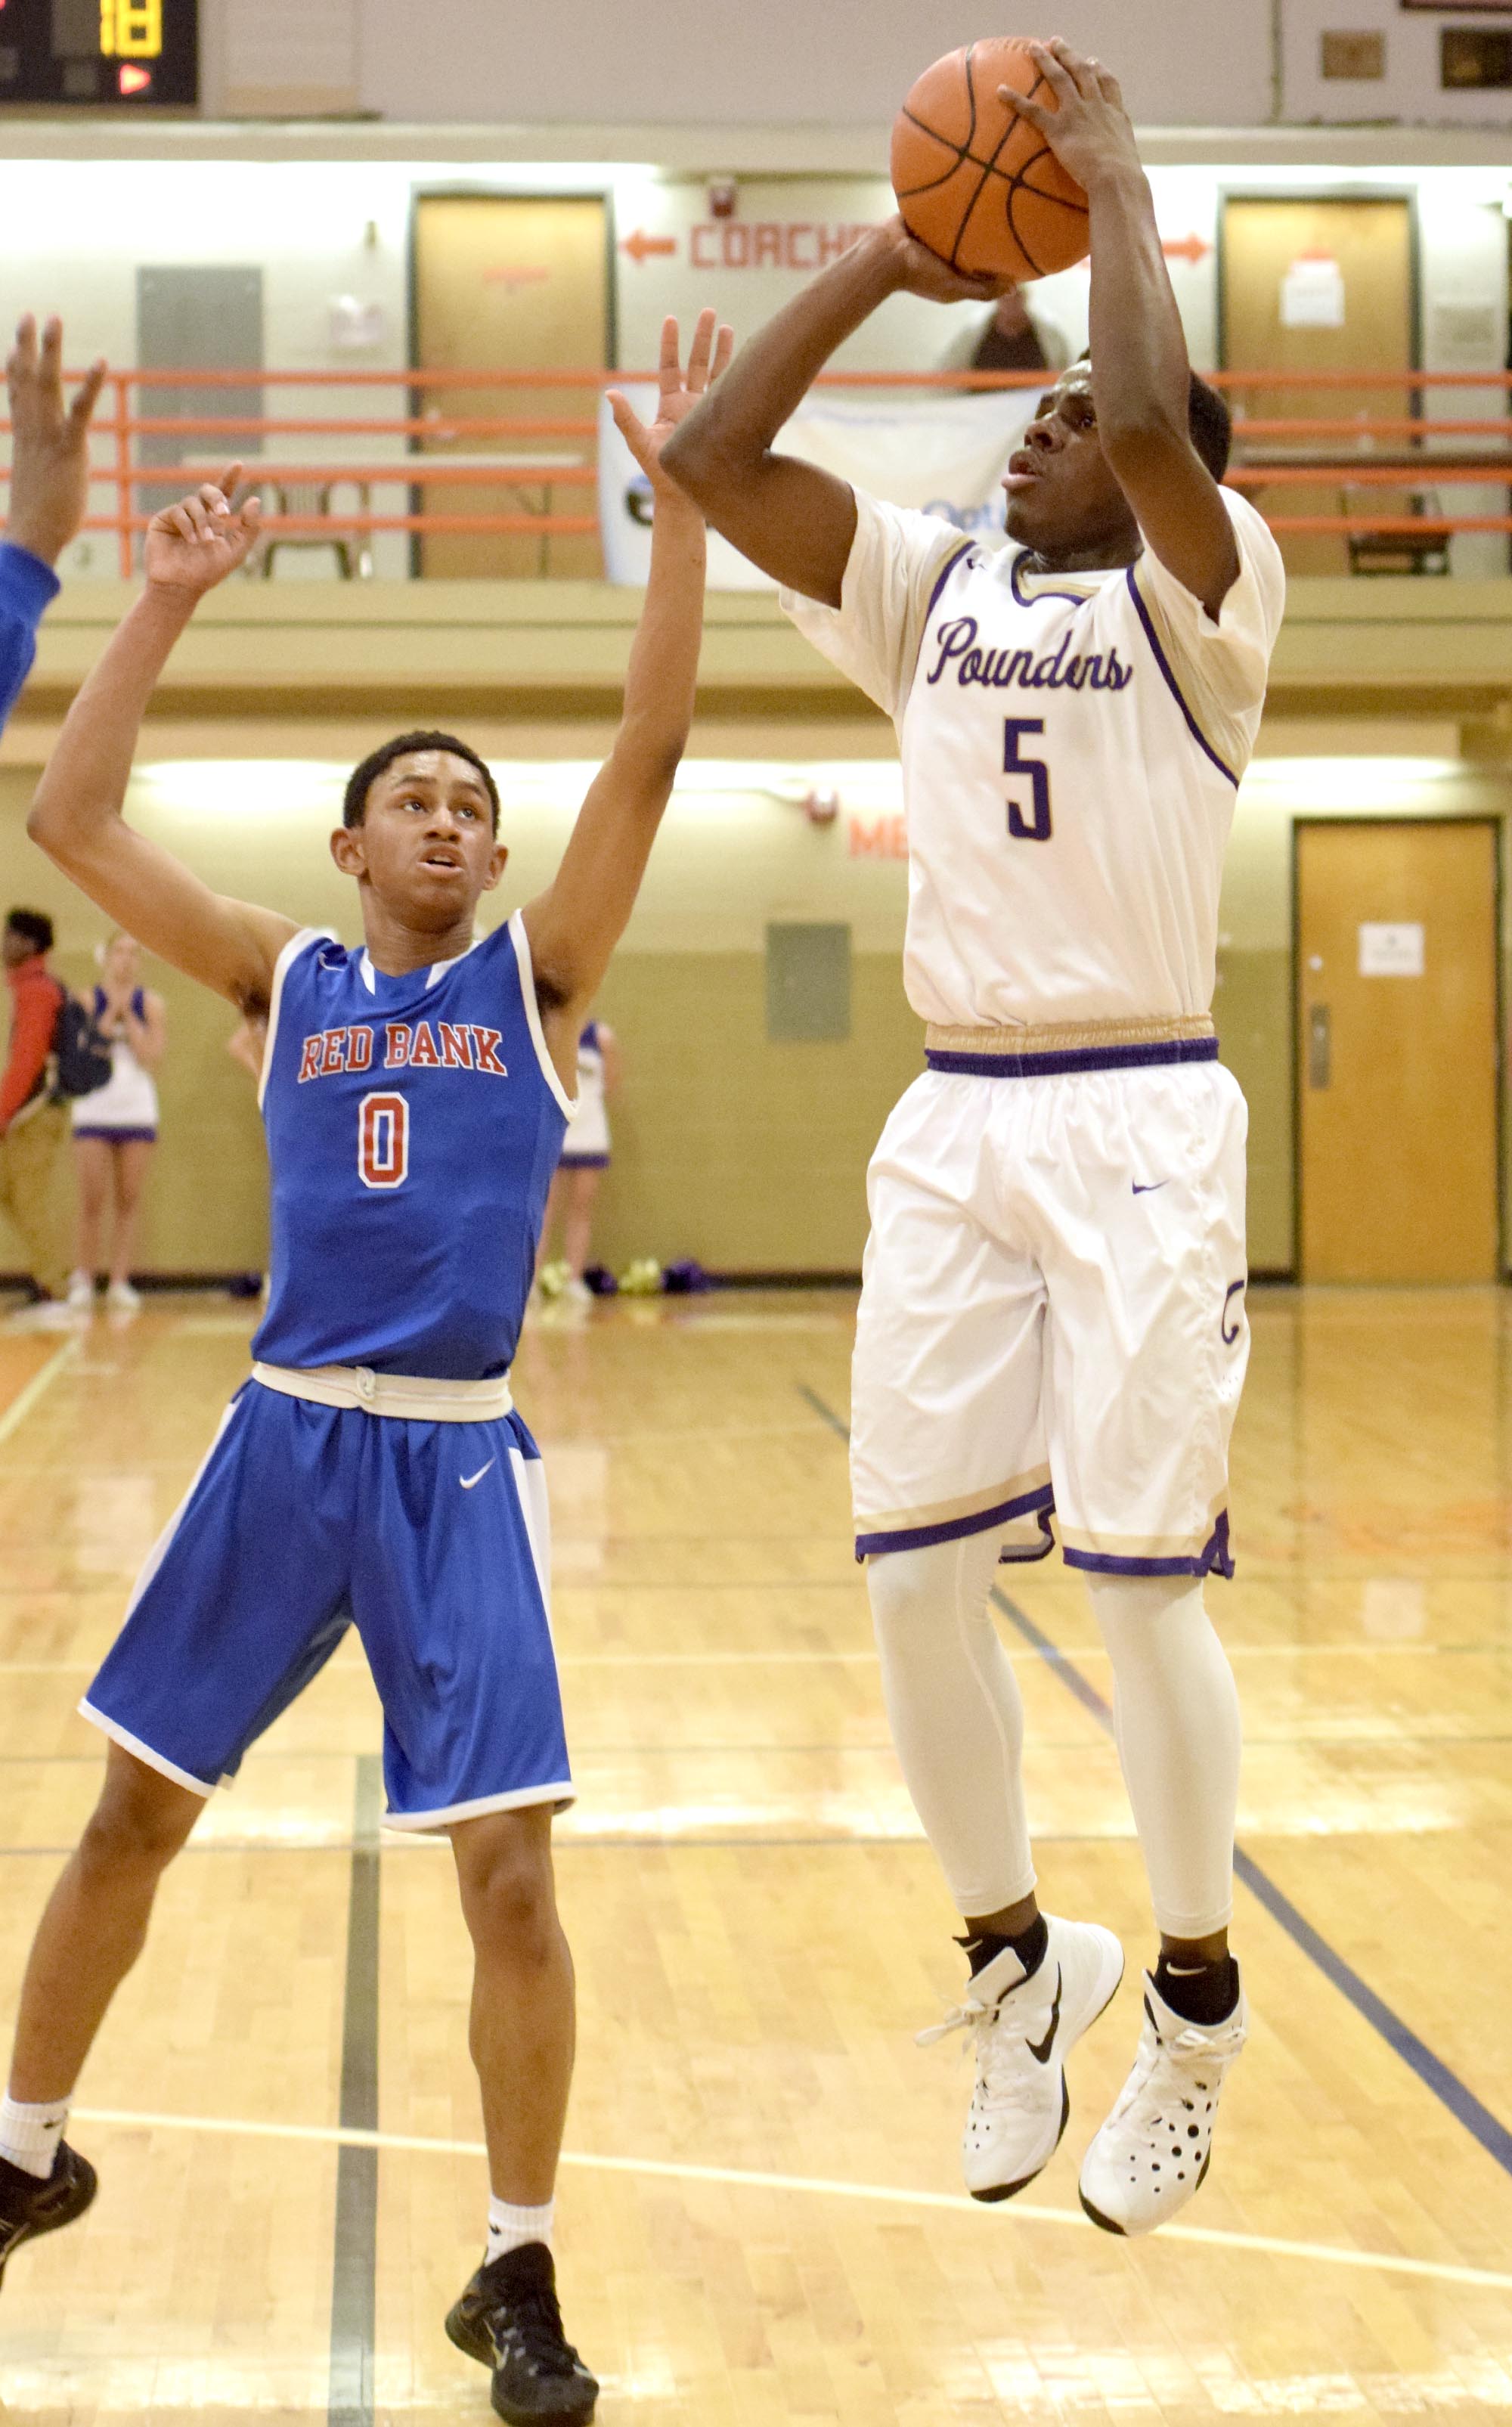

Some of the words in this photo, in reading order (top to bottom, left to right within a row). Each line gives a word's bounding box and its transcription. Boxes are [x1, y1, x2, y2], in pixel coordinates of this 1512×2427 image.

[690, 224, 872, 271] COACH
[927, 616, 1132, 690] Pounders
[1003, 717, 1052, 842] 5
[298, 1025, 374, 1083] RED
[384, 1021, 508, 1077] BANK
[358, 1092, 409, 1189] 0
